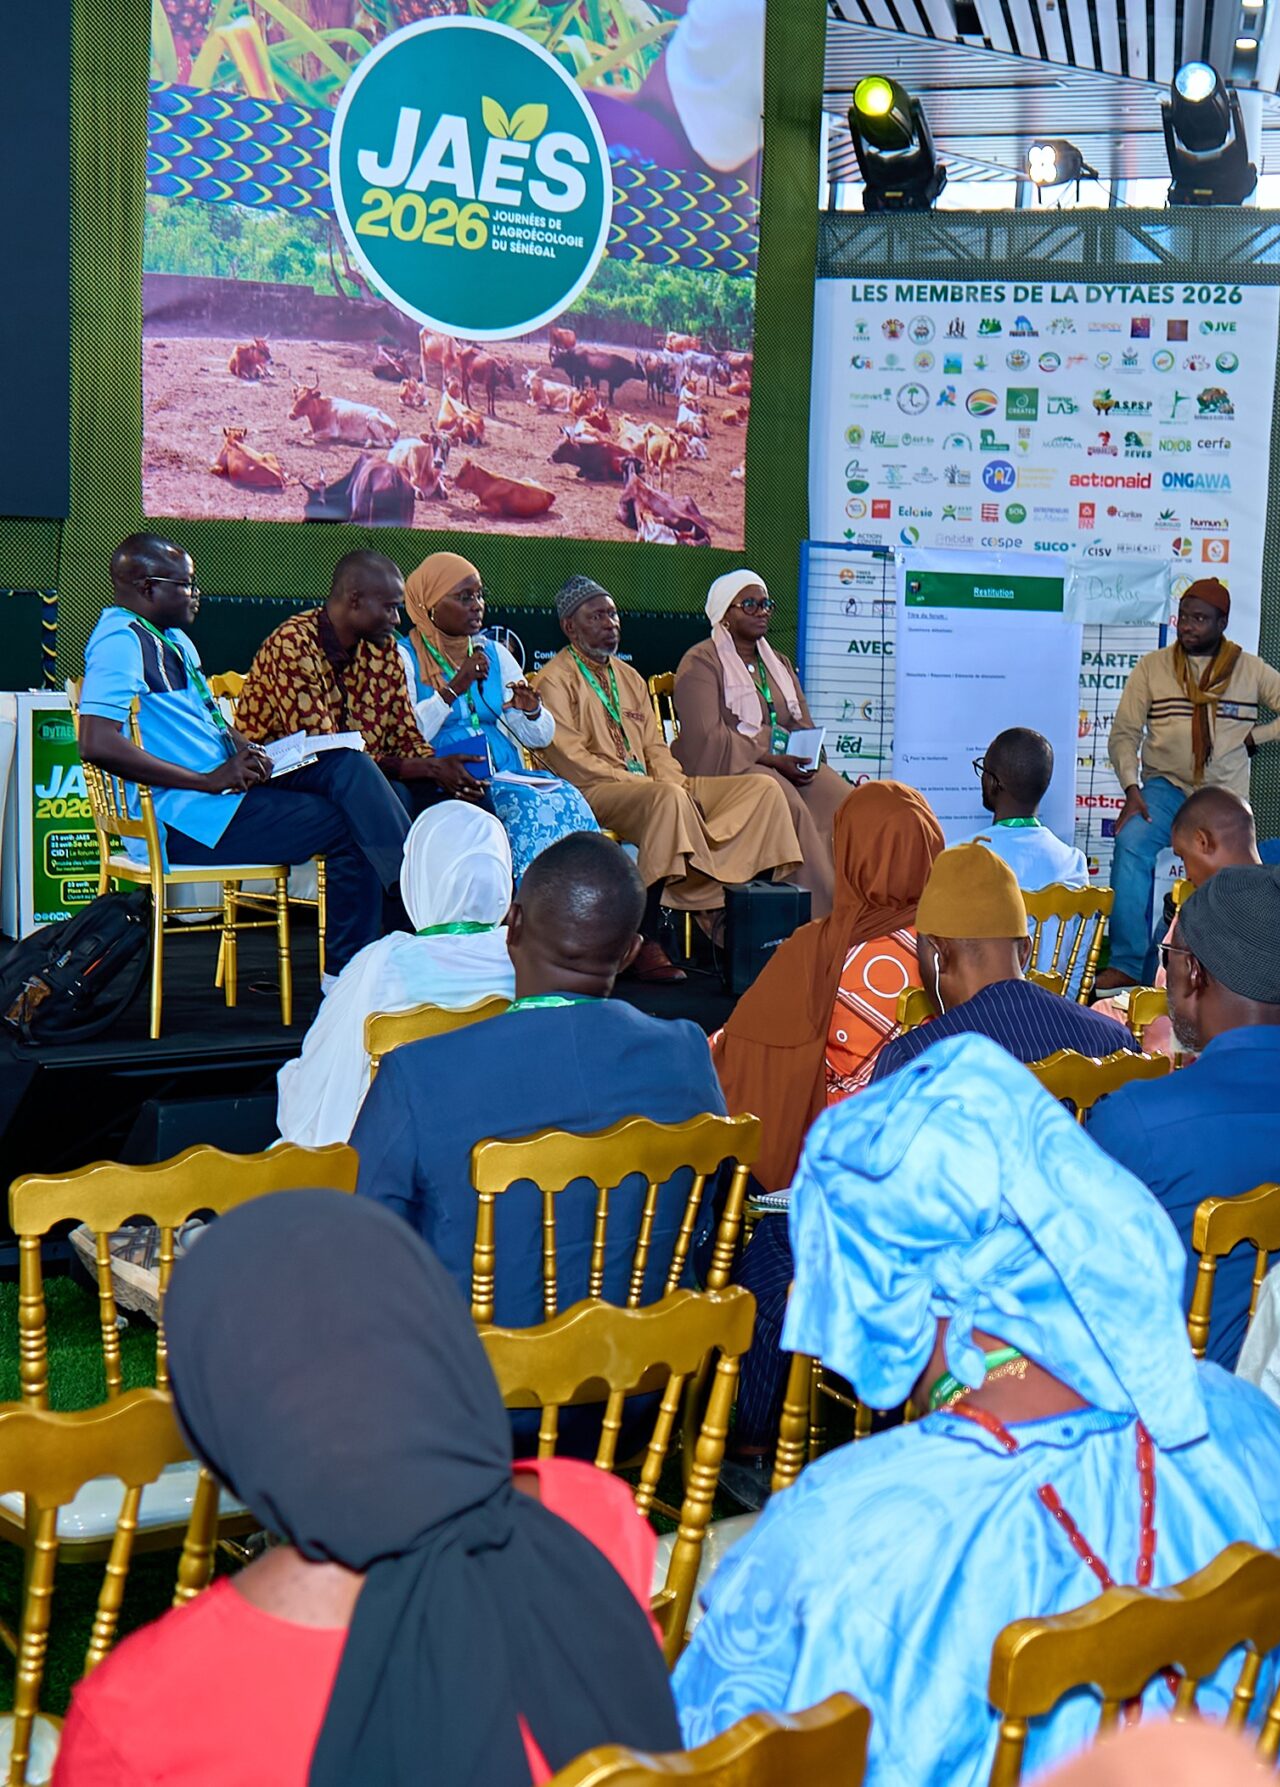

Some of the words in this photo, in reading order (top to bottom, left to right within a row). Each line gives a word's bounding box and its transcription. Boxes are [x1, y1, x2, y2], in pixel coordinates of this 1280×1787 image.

[356, 106, 591, 213] JAES
[355, 188, 490, 250] 2026
[492, 210, 546, 228] JOURNÉES
[548, 218, 562, 230] DE
[492, 226, 584, 248] L'AGROÉCOLOGIE
[491, 240, 508, 252] DU
[509, 242, 556, 259] SÉNÉGAL
[851, 285, 888, 302] LES
[895, 285, 1006, 303] MEMBRES
[1013, 285, 1043, 303] DE
[1051, 285, 1079, 303] LA
[1085, 285, 1175, 304] DYTAES
[1182, 286, 1242, 305] 2026
[1214, 322, 1237, 333] JVE
[1197, 438, 1232, 449] cerfa
[1162, 472, 1232, 489] ONGAWA
[1033, 541, 1069, 552] suco
[973, 587, 1015, 598] Restitution
[847, 640, 894, 655] AVEC
[1081, 652, 1146, 669] PARTE
[35, 765, 89, 799] JA
[35, 799, 93, 818] 2026
[51, 849, 65, 857] CID
